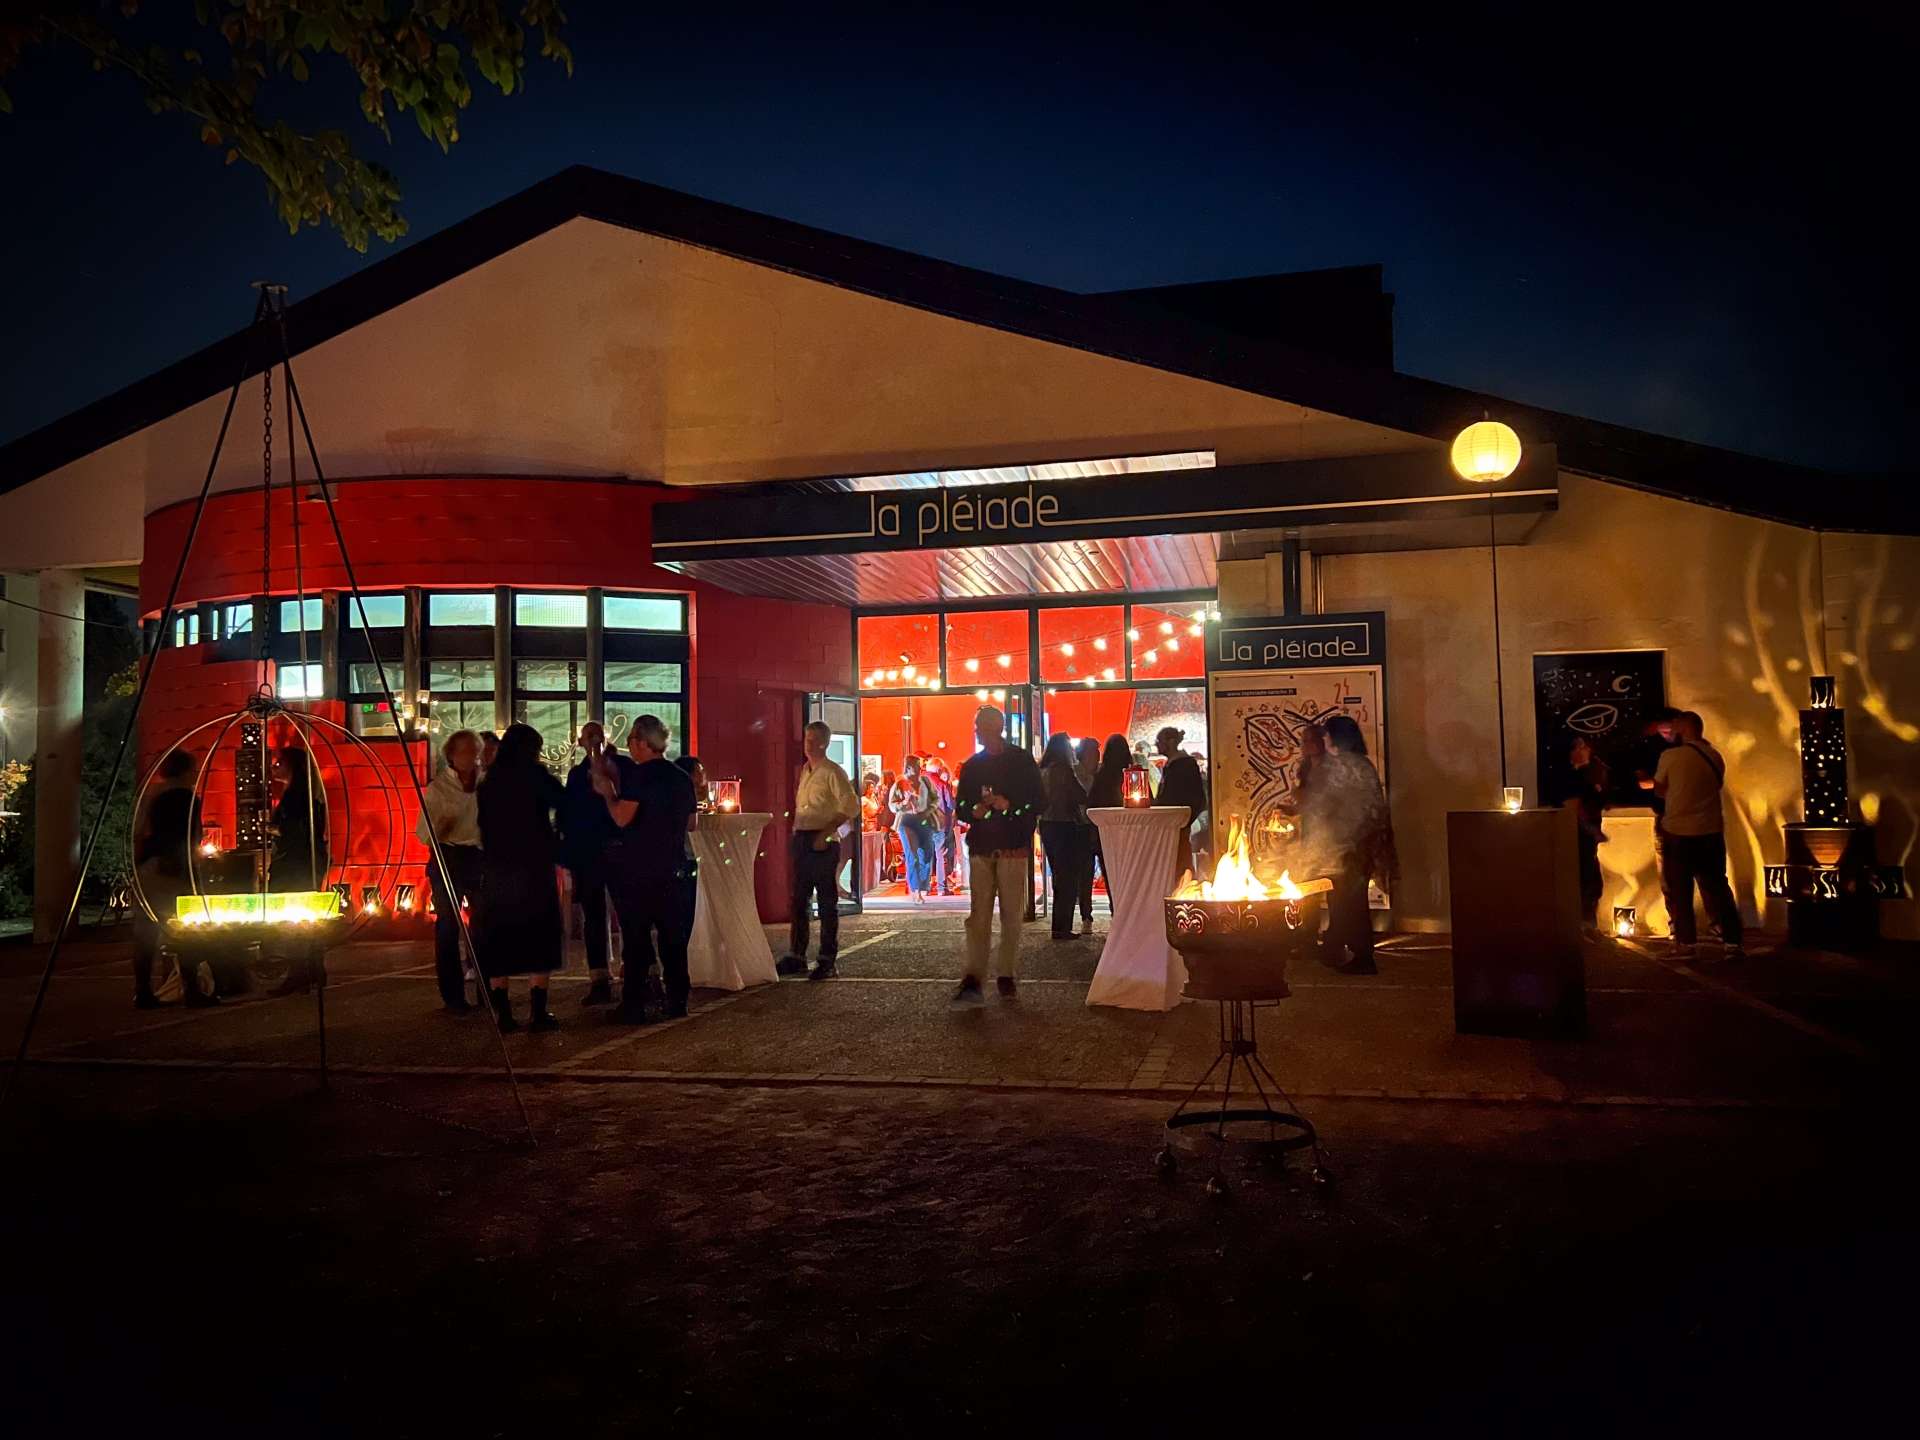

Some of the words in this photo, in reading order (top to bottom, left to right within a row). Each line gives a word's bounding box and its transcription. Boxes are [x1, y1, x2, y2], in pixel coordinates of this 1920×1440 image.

[870, 494, 900, 536] la
[919, 484, 1059, 545] pléiade
[1232, 640, 1253, 662] la
[1264, 636, 1357, 665] pléiade
